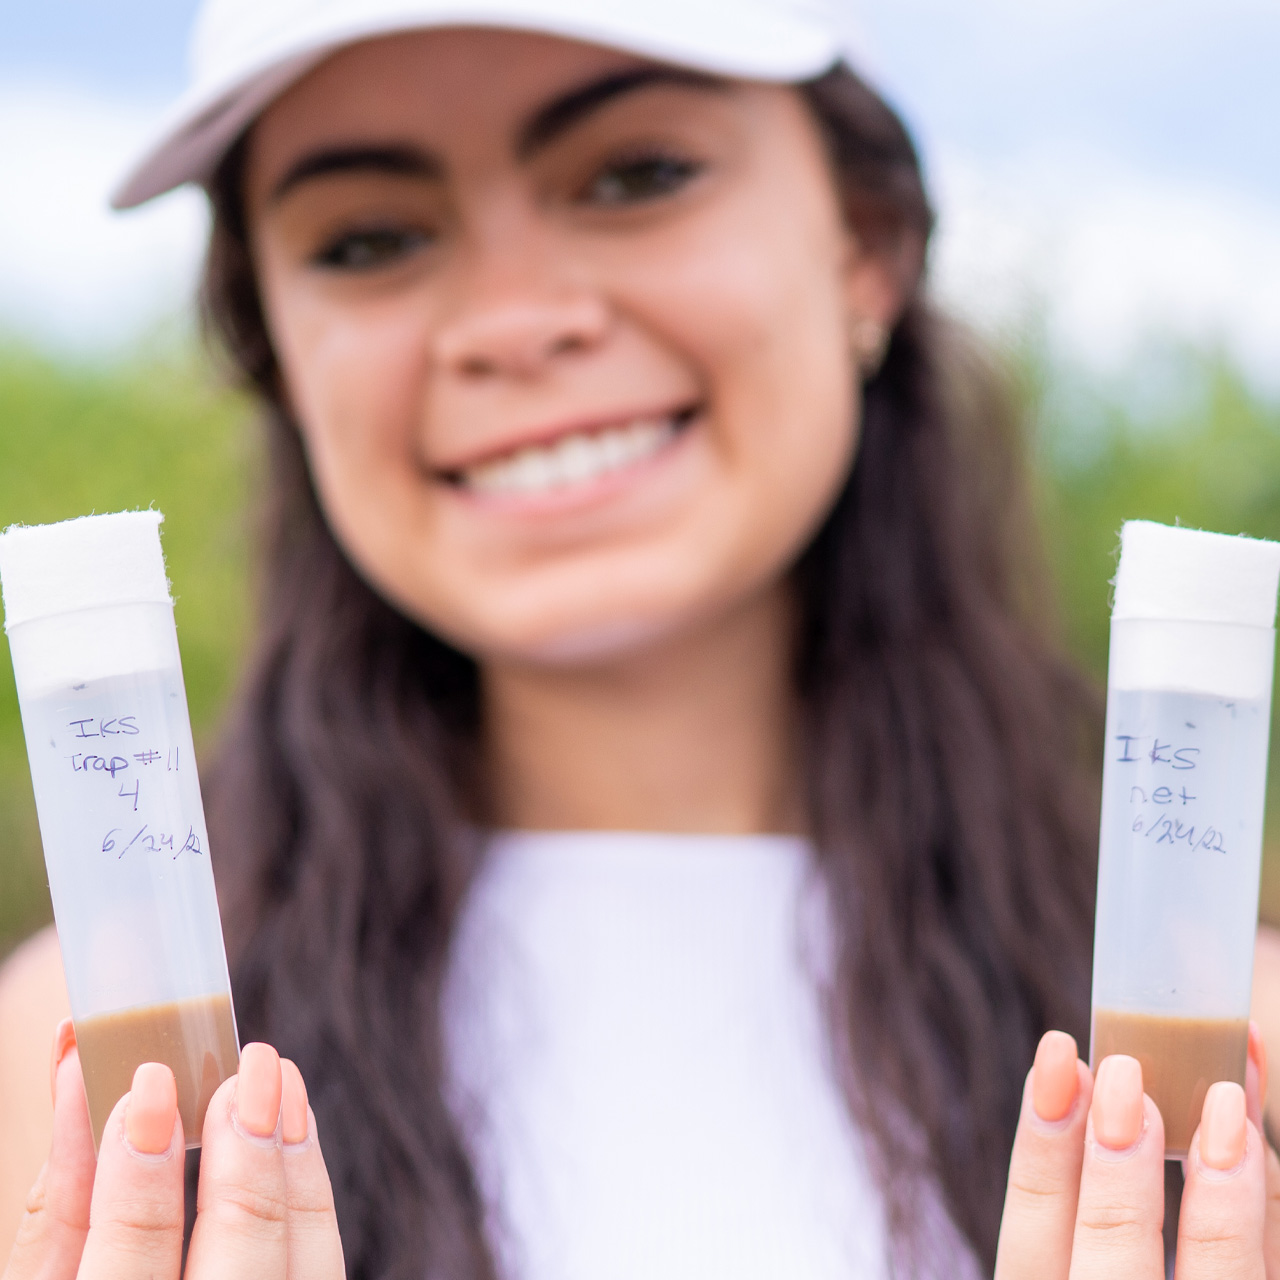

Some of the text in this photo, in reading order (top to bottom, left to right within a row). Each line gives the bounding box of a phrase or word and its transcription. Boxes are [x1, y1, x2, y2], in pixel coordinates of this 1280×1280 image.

[69, 716, 140, 738] IKS
[1115, 735, 1201, 770] IKS
[118, 778, 140, 811] 4
[1130, 786, 1196, 805] net
[1131, 812, 1226, 854] 6/24/22
